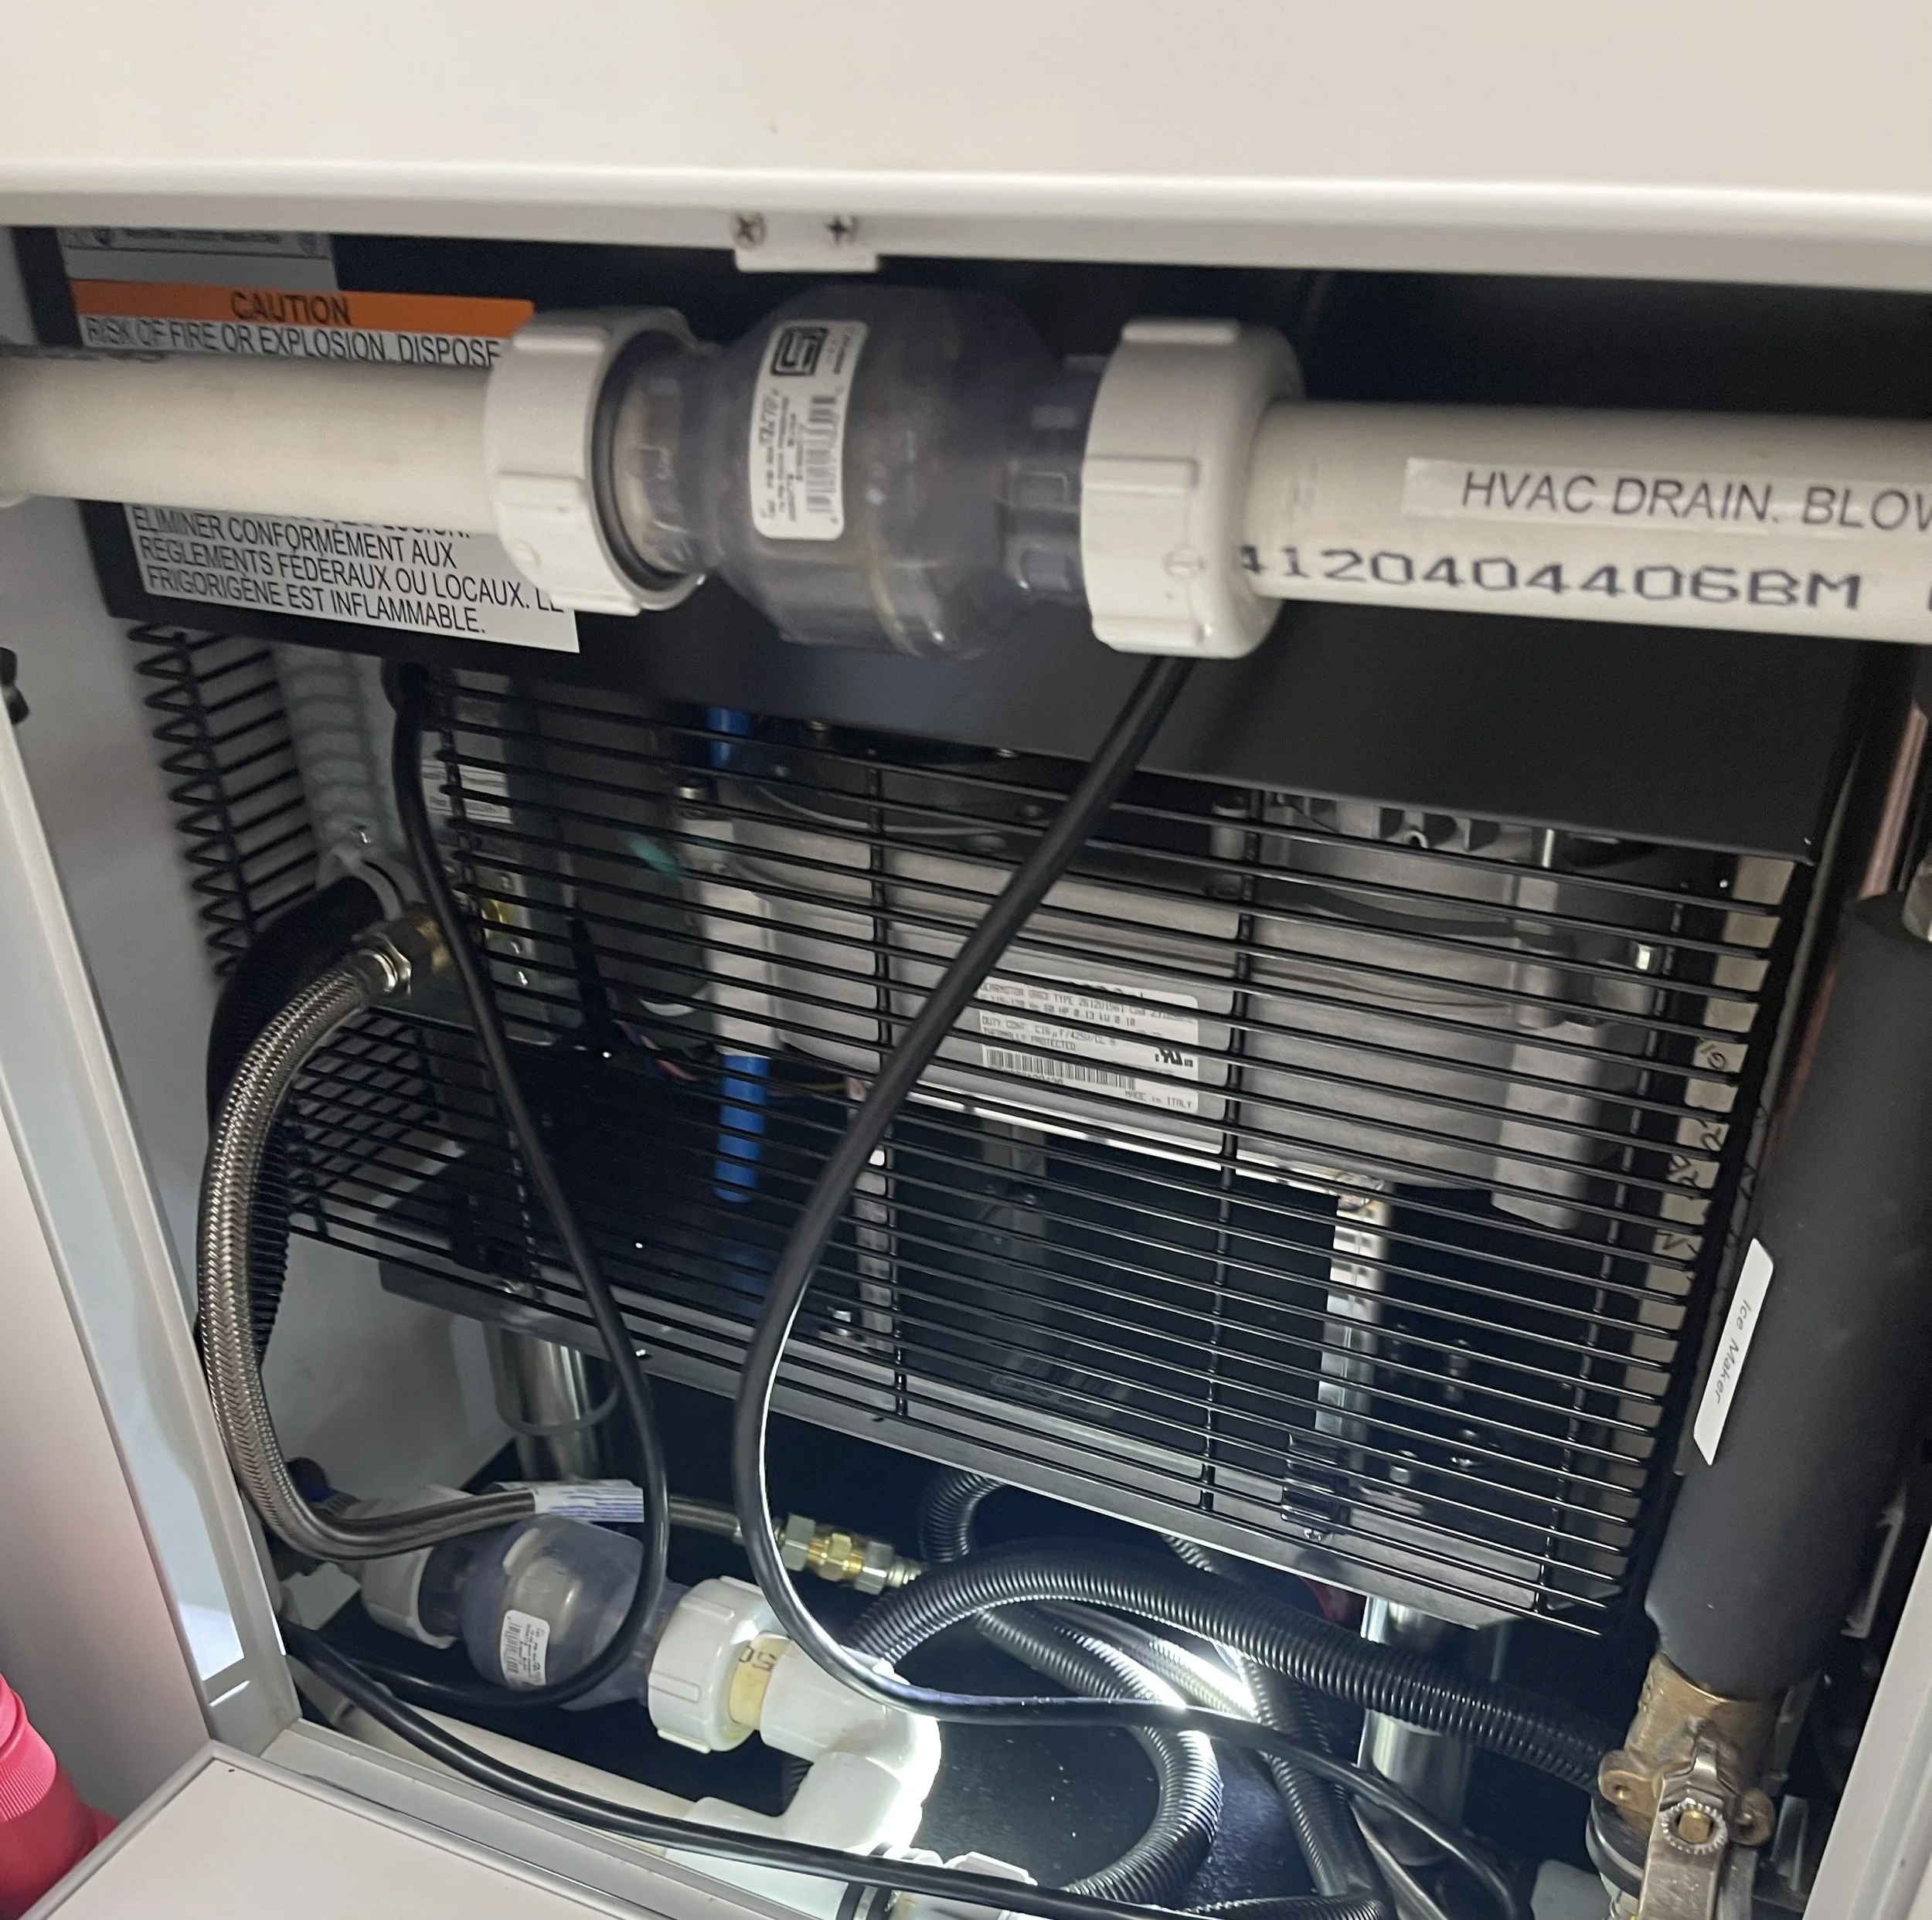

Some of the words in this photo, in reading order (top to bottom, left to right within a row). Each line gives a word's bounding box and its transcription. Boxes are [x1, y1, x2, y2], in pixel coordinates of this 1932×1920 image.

[232, 291, 352, 326] CAUTION
[85, 316, 130, 347] RISK
[137, 318, 167, 347] OF
[169, 321, 216, 349] FIRE
[222, 325, 253, 352] OR
[1461, 469, 1597, 514] HVAC
[1611, 475, 1781, 524] DRAIN.
[412, 539, 457, 569] AUX
[395, 567, 427, 596] OU
[432, 572, 530, 609] LOCAUX.
[286, 583, 325, 612] EST
[330, 590, 486, 634] INFLAMMABLE.
[1053, 994, 1074, 1005] TYPE
[1124, 1090, 1147, 1102] MADE
[1167, 1096, 1192, 1109] ITALY
[1736, 1299, 1752, 1330] Ice
[1715, 1337, 1740, 1405] Maker
